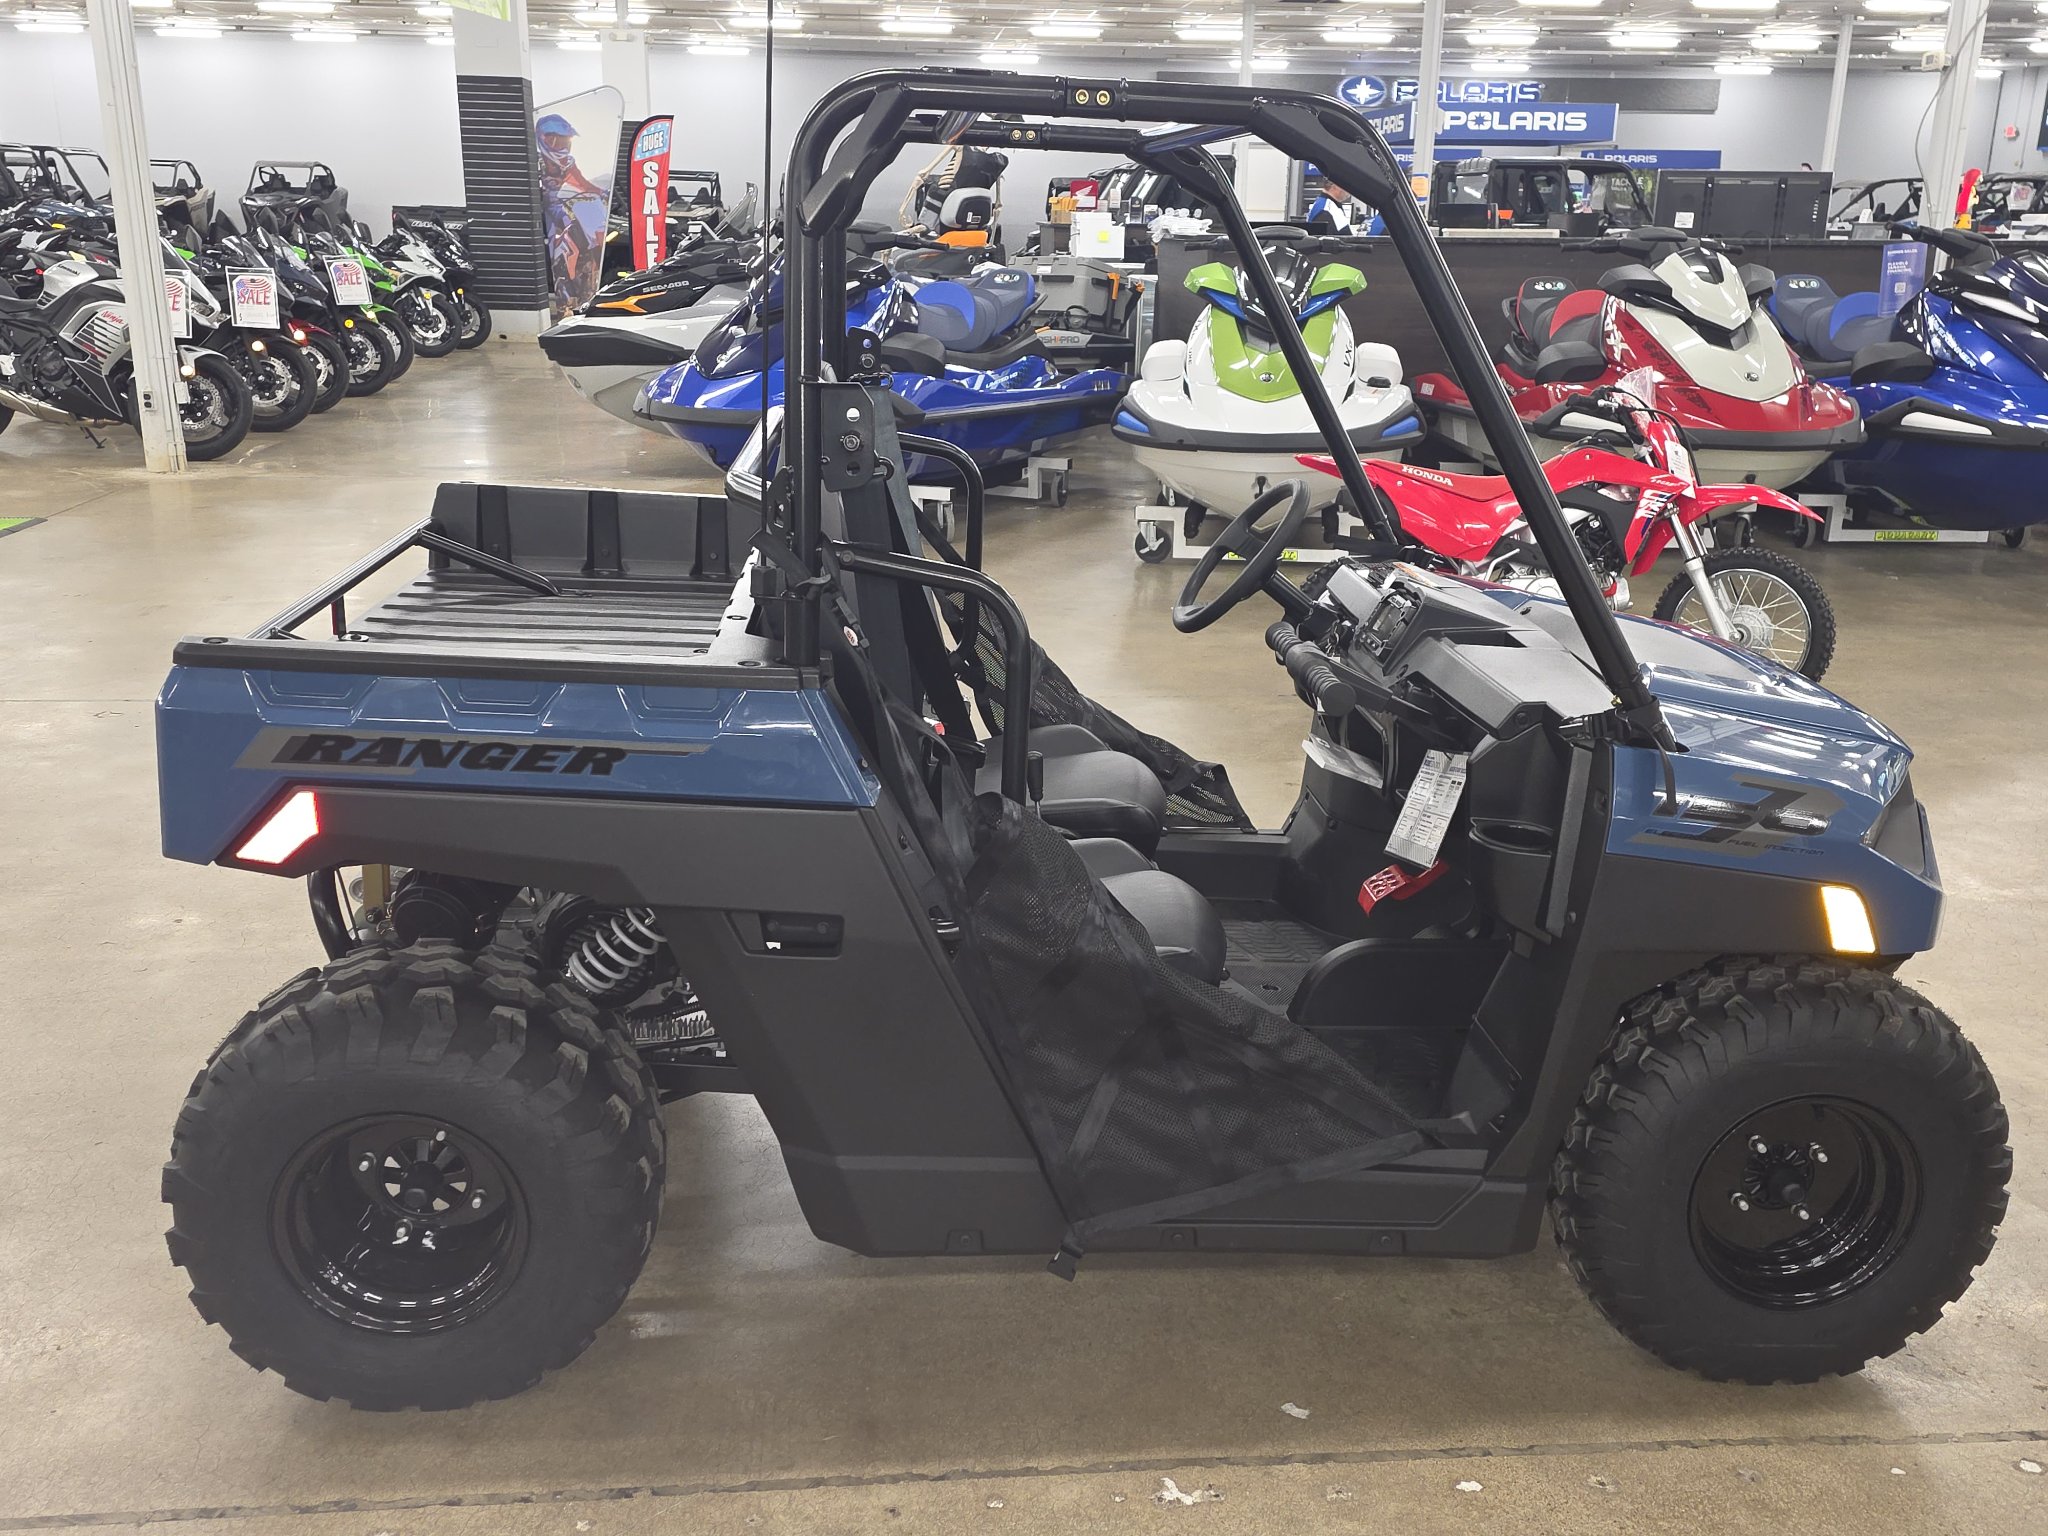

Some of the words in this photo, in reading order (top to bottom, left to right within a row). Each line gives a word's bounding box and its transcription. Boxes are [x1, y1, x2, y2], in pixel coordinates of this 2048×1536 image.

[1392, 79, 1541, 104] PLARIS
[1444, 111, 1588, 132] POLARIS
[643, 131, 665, 154] HUGE
[1604, 154, 1658, 163] POLARIS
[642, 160, 660, 272] SALE
[338, 270, 362, 287] SALE
[238, 287, 271, 306] SALE
[101, 310, 124, 325] Ninja
[1401, 464, 1453, 487] HONDA
[292, 733, 628, 776] RANGER
[1726, 838, 1759, 848] FUEL
